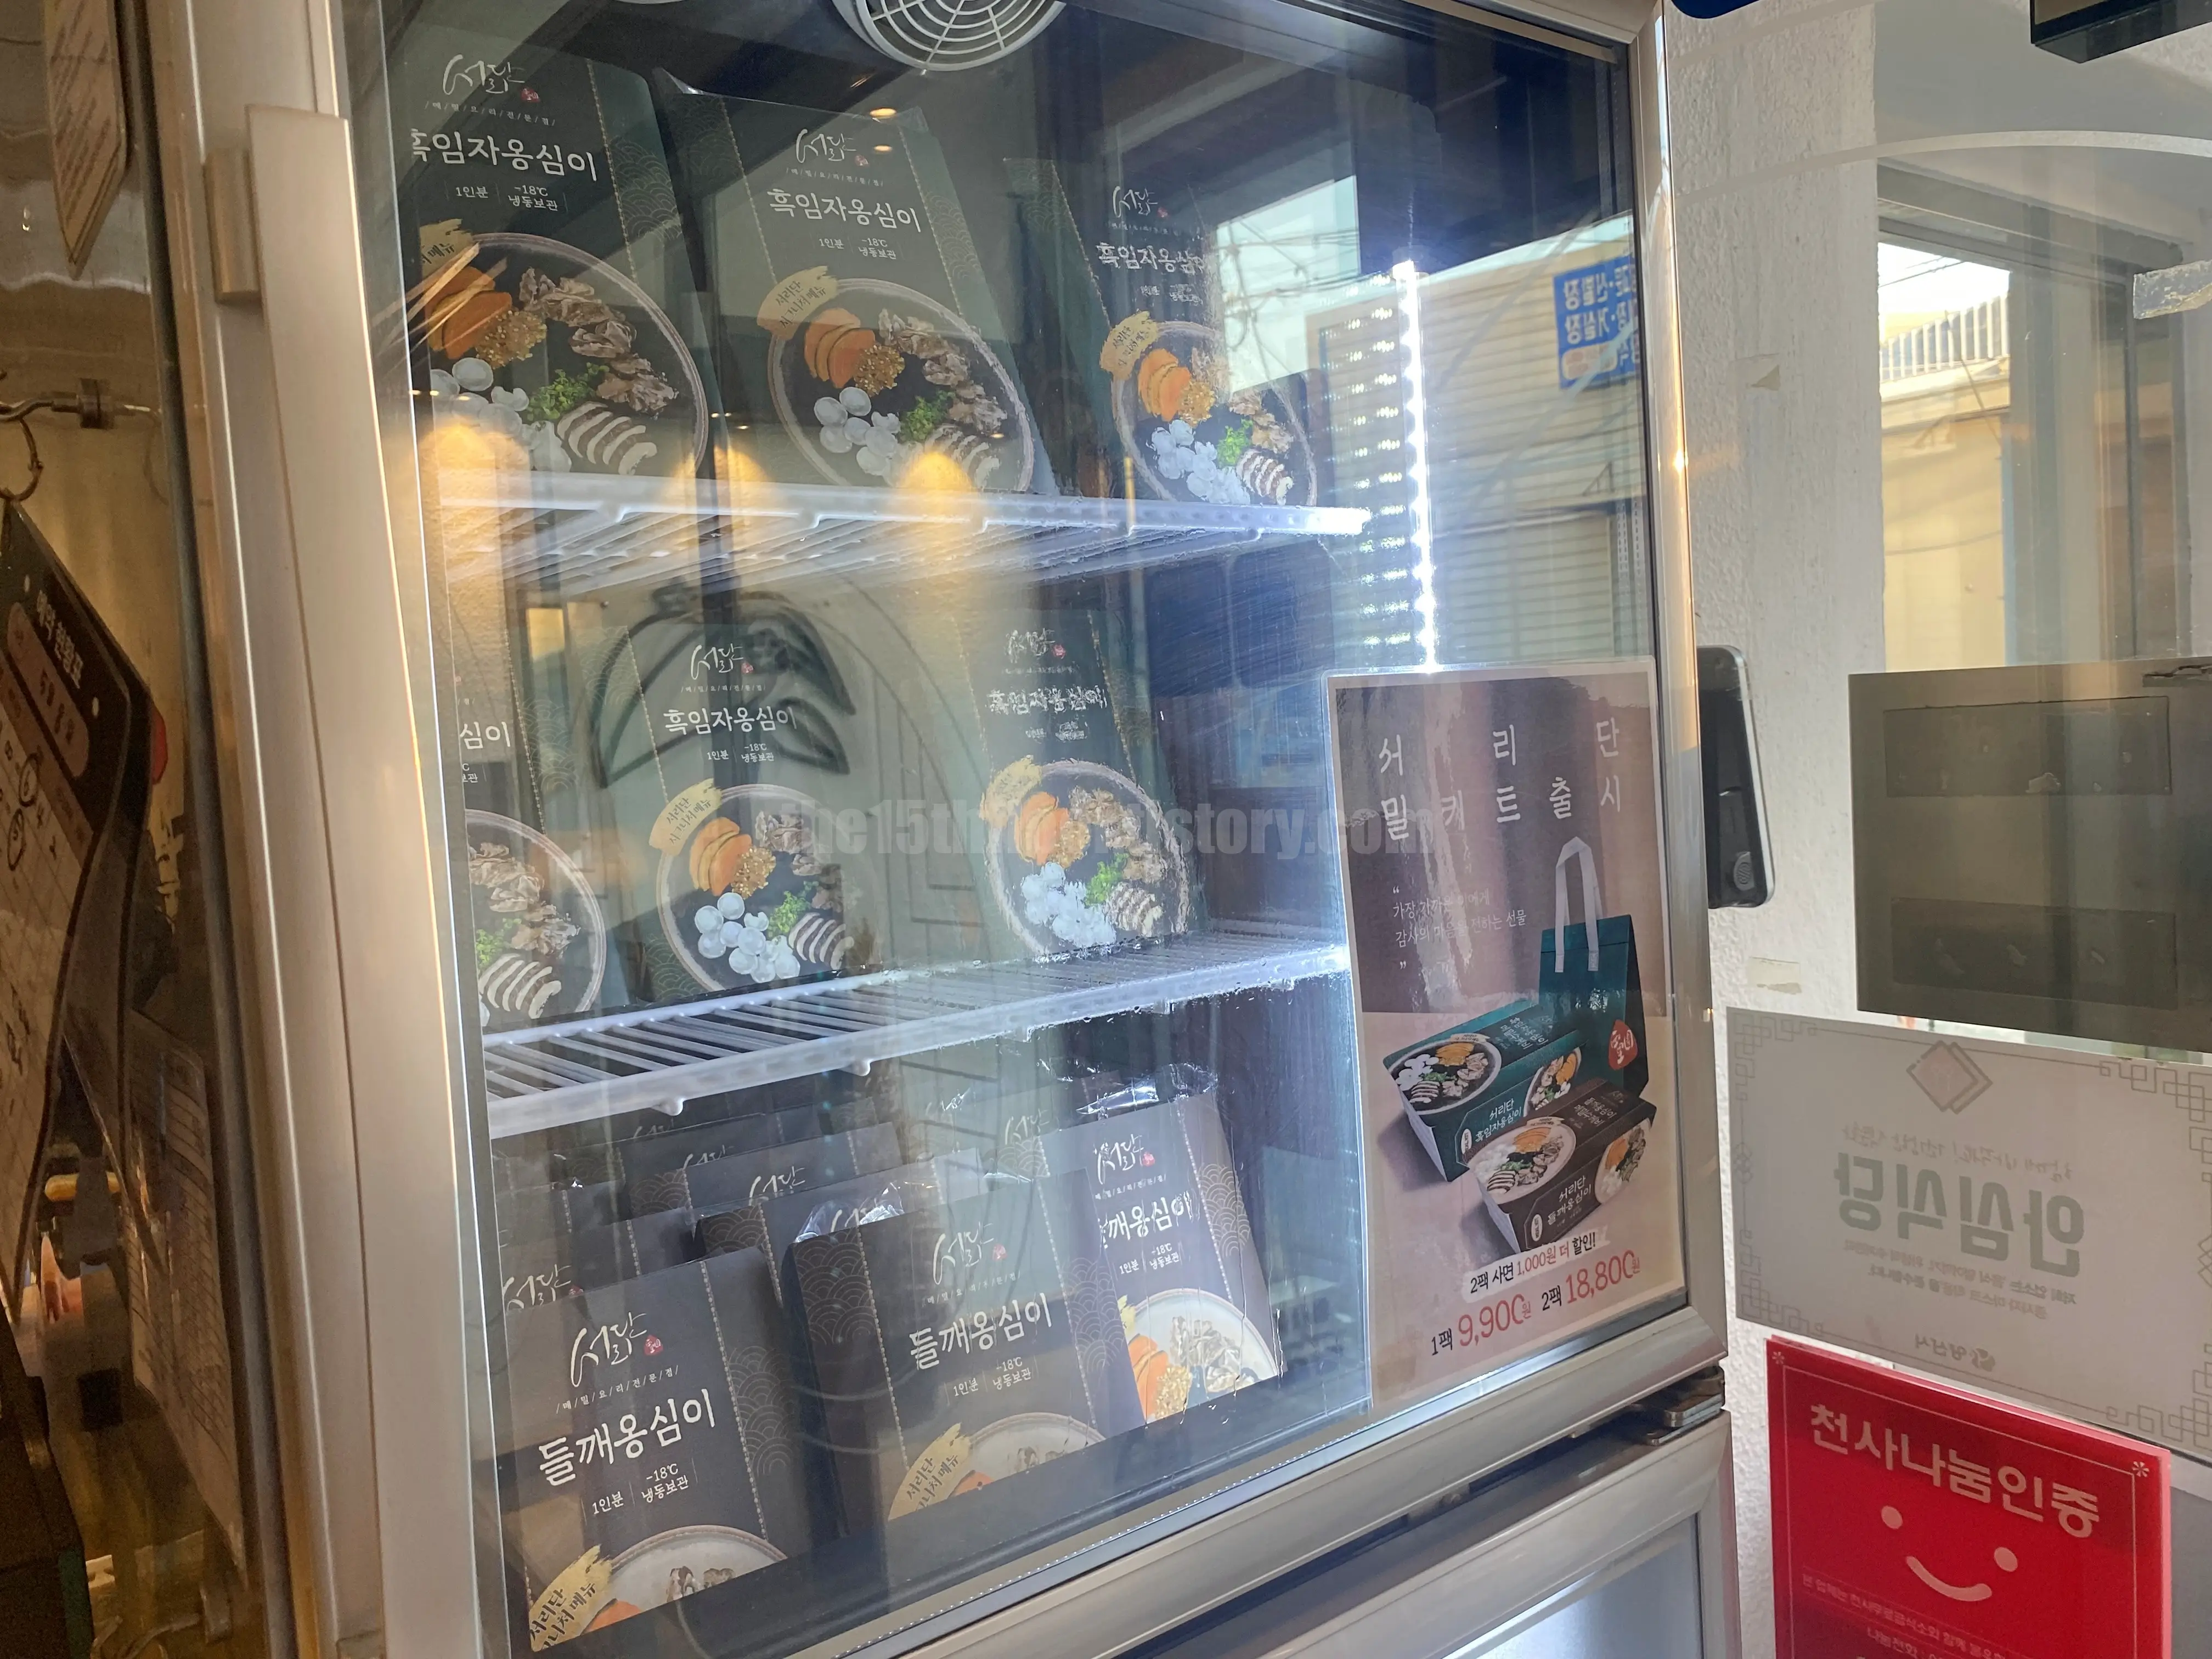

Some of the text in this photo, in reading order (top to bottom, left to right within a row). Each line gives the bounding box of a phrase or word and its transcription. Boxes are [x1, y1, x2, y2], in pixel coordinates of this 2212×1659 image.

[456, 187, 488, 198] 1인분
[508, 195, 558, 211] 냉동보관
[766, 188, 922, 233] 흑임자옹심이
[819, 239, 844, 250] 1인분
[859, 246, 896, 260] 냉동보관
[775, 281, 804, 306] 서리단
[780, 286, 826, 329] 시그니처 메뉴
[663, 706, 798, 735] 흑임자옹심이
[707, 750, 729, 760] 1인분
[741, 752, 775, 763] 냉동보관
[667, 797, 691, 824] 서리단
[669, 799, 712, 845] 시그니처 메뉴
[1392, 900, 1416, 920] 가장
[1395, 924, 1430, 949] 감사의
[1506, 909, 1527, 927] 선물
[1489, 1097, 1515, 1121] 서리단
[1475, 1106, 1522, 1142] 흑임자옹심이
[1559, 1175, 1586, 1203] 서리단
[1098, 1190, 1193, 1249] 깨옹심이
[1119, 1259, 1139, 1274] 1인분
[1149, 1251, 1180, 1270] 냉동보관
[1470, 1232, 1596, 1294] 2팩 사면 1,000원 더 할인!
[909, 1292, 1052, 1371] 들깨옹심이
[1431, 1327, 1453, 1356] 1팩
[1542, 1285, 1562, 1311] 2팩
[953, 1367, 1032, 1397] 1인분 냉동보관
[538, 1388, 715, 1486] 들깨옹심이
[906, 1457, 936, 1500] 서리단
[938, 1454, 958, 1477] 메뉴
[1810, 1402, 2101, 1538] 천사나눔인증
[592, 1475, 689, 1516] 1인분 냉동보관
[569, 1583, 596, 1610] 메뉴
[529, 1588, 567, 1642] 서리단
